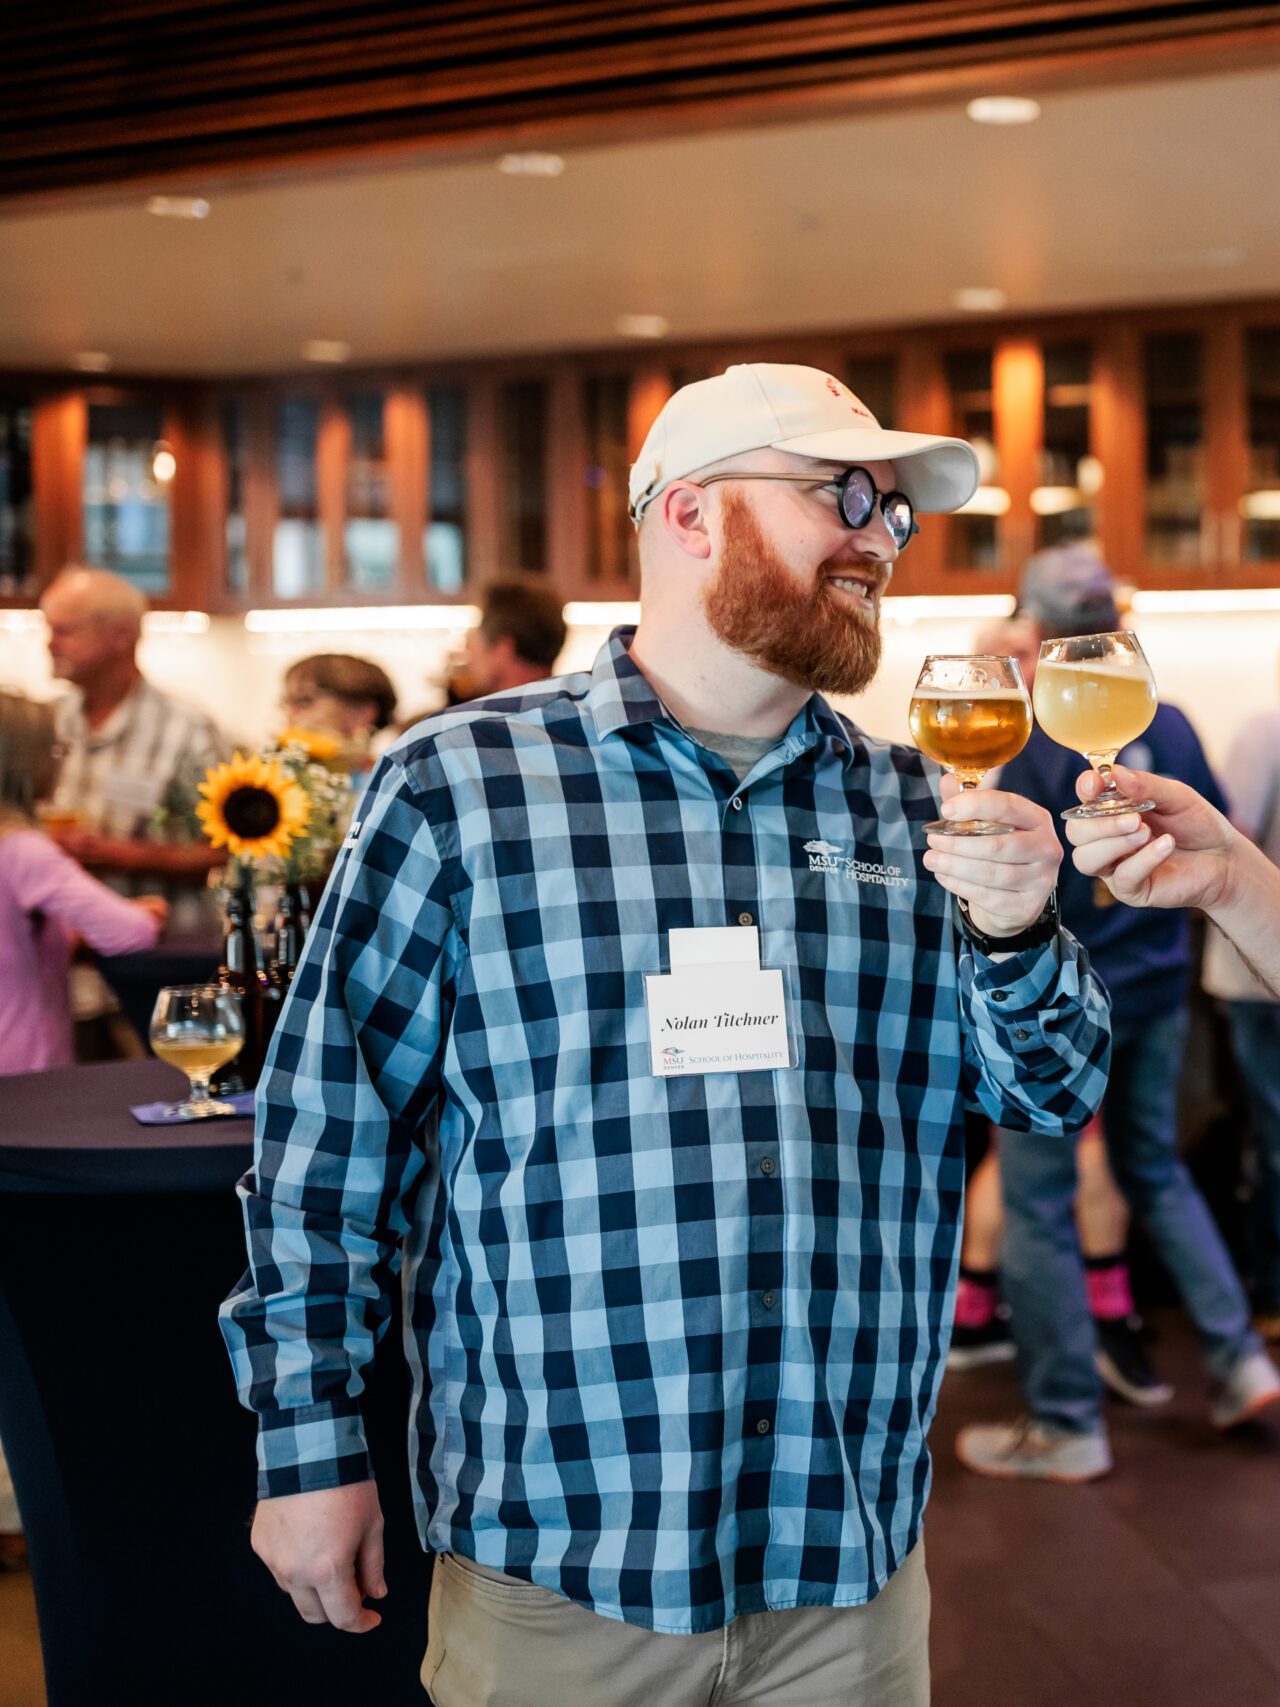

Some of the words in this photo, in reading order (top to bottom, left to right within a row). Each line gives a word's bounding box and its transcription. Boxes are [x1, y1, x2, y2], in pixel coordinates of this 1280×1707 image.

[845, 857, 886, 875] SCHOOL
[887, 865, 902, 877] OF
[846, 869, 909, 887] HOSPITALITY
[661, 1016, 708, 1032] Nolan
[713, 1012, 779, 1028] Titchner
[663, 1057, 684, 1066] MSU
[688, 1054, 721, 1064] SCHOOL
[722, 1053, 733, 1062] OF
[735, 1051, 783, 1061] HOSPITALITY
